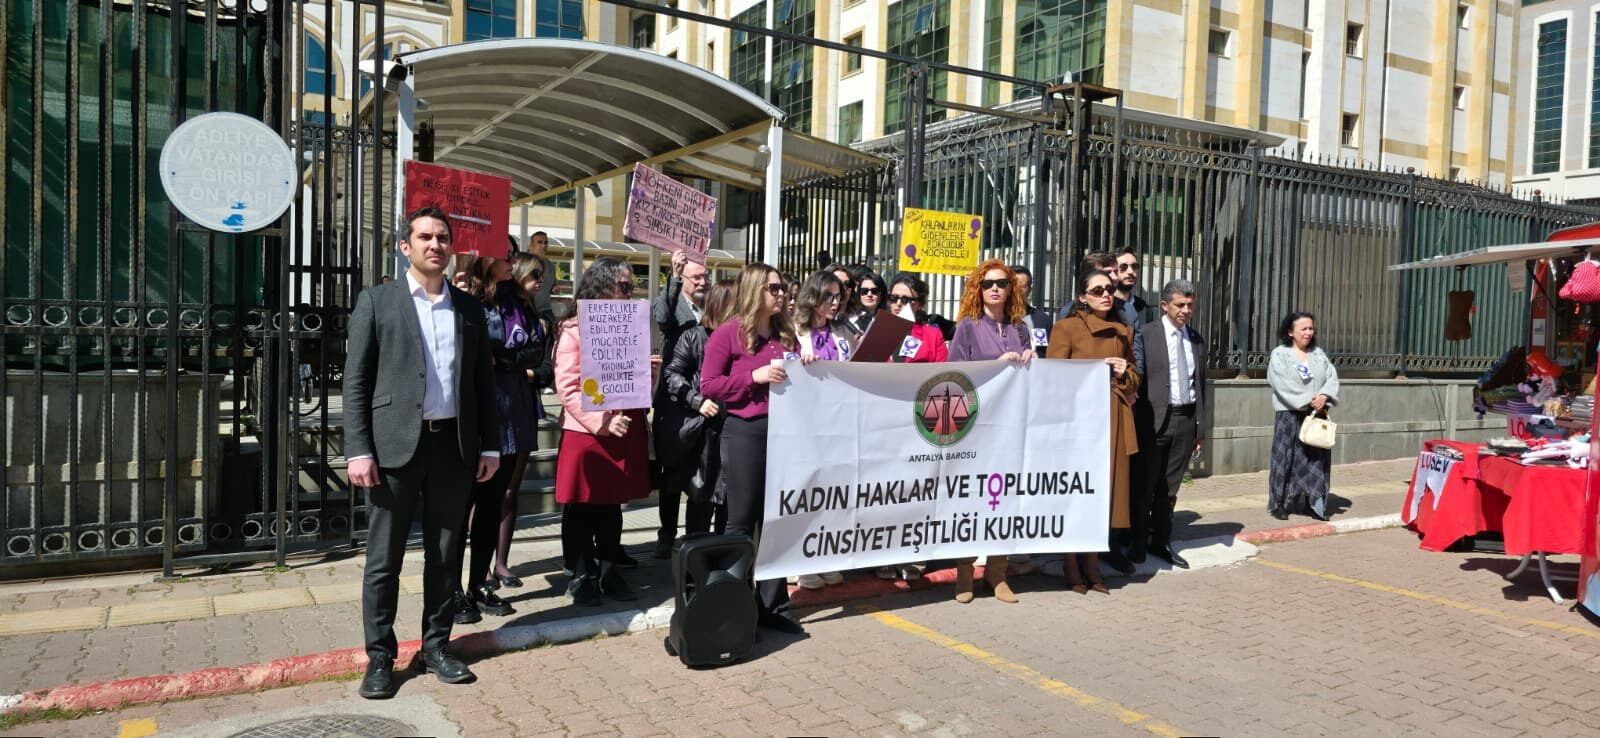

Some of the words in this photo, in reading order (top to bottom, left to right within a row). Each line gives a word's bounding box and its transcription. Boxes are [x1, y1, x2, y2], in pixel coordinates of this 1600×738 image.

[226, 190, 272, 208] KAPI
[909, 453, 943, 463] ANTALYA
[946, 451, 977, 461] BAROSU
[779, 485, 849, 516] KADIN
[856, 477, 939, 508] HAKLARI
[946, 475, 970, 498] VE
[977, 471, 1095, 511] TOPLUMSAL
[803, 523, 897, 558] CİNSİYET
[901, 512, 978, 553] EŞİTLİĞİ
[984, 515, 1064, 541] KURULU
